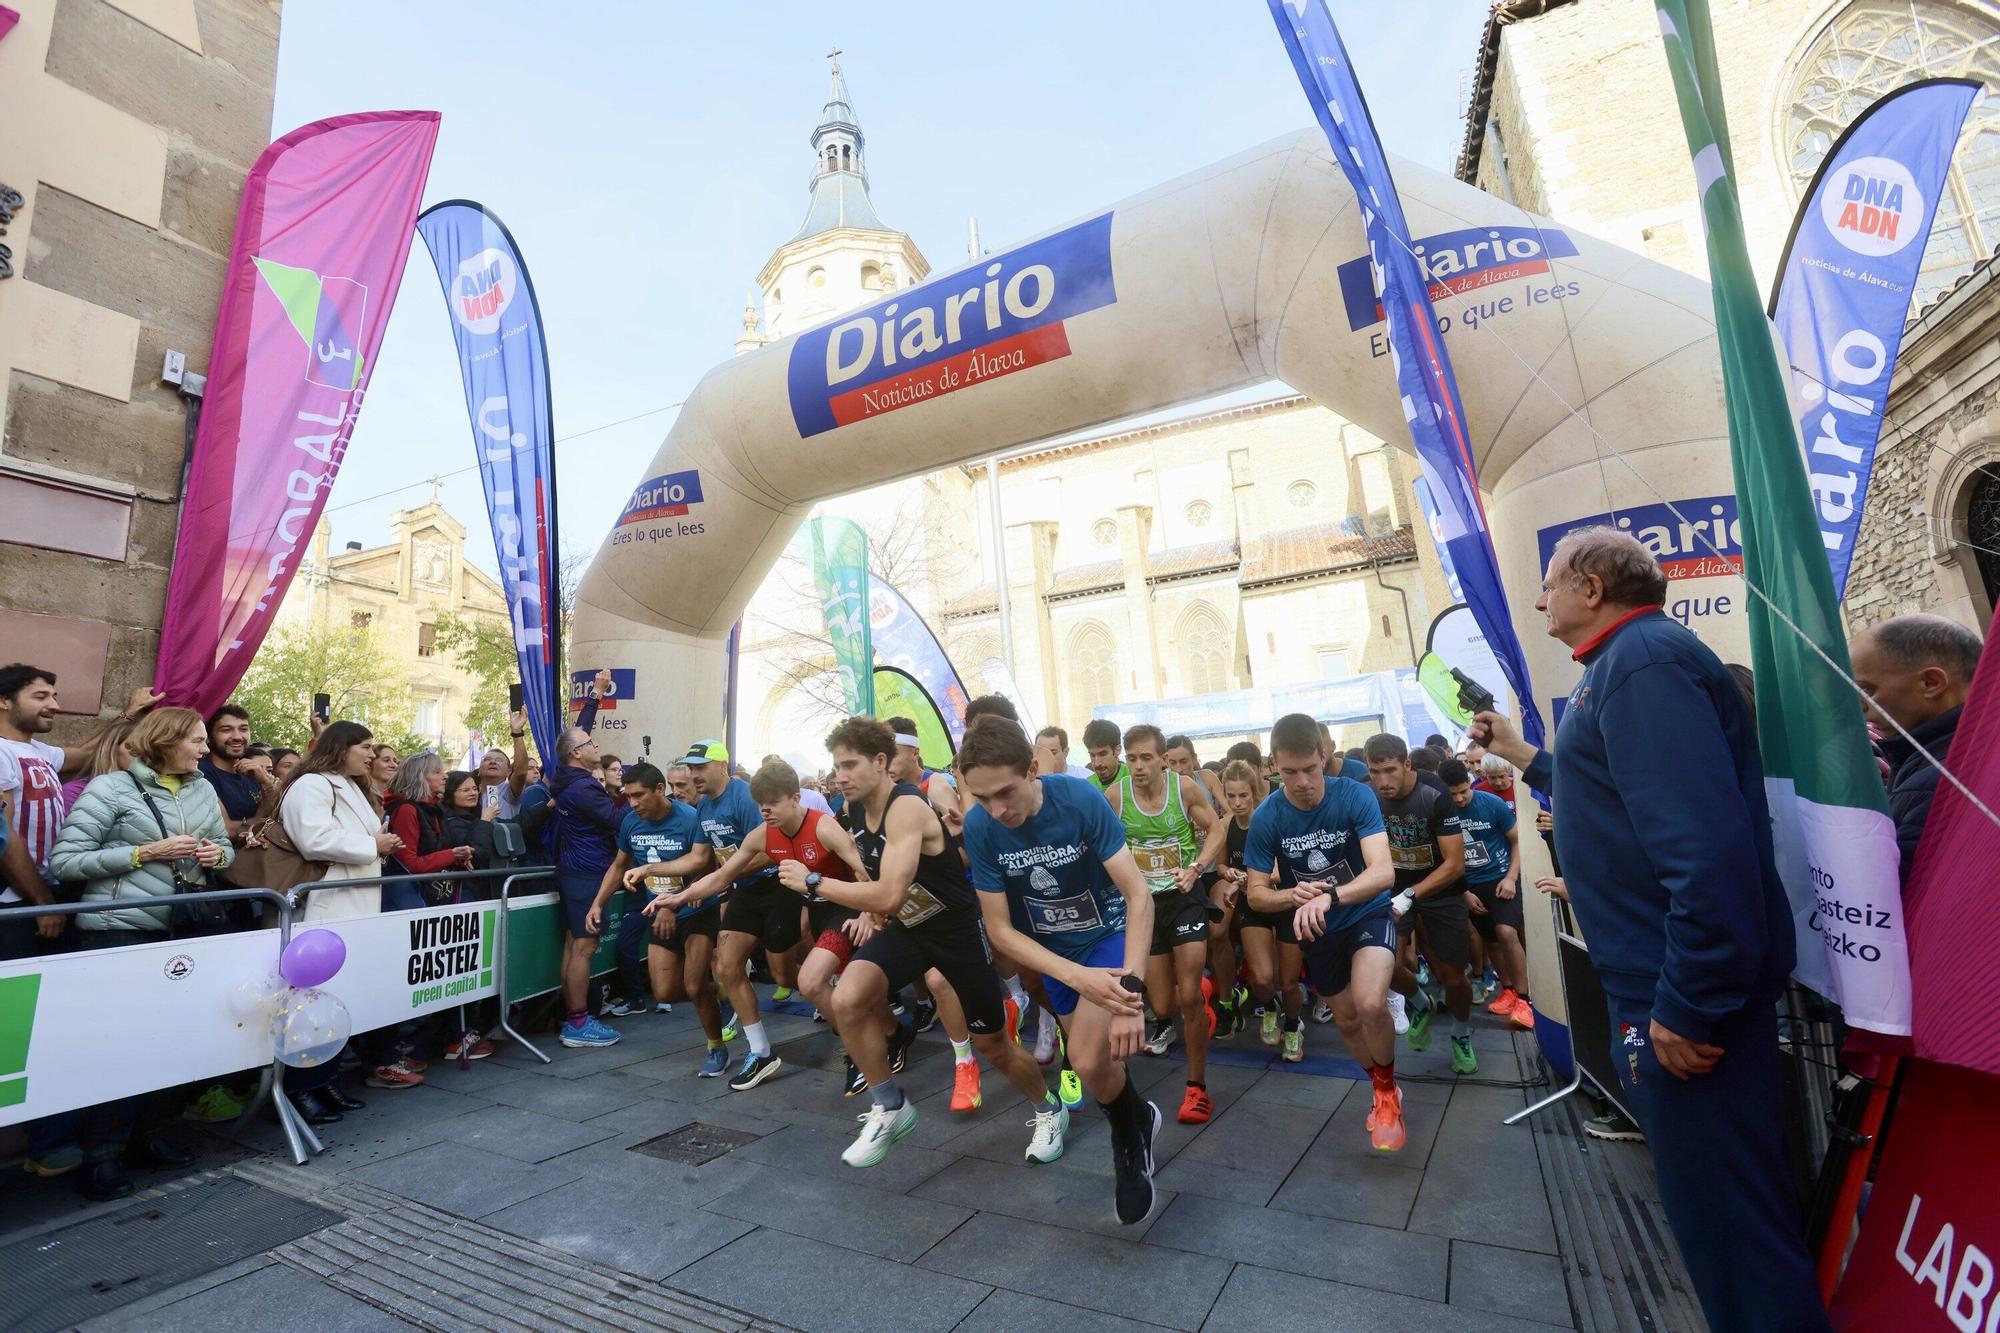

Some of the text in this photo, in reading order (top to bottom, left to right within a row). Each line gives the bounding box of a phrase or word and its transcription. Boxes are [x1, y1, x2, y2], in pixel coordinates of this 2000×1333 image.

[1843, 173, 1903, 214] DNA
[1838, 203, 1901, 240] ADN
[1370, 231, 1541, 299] iario
[1457, 278, 1473, 292] de
[1477, 268, 1521, 286] Álava
[1801, 256, 1840, 274] noticias
[1843, 268, 1856, 279] de
[1463, 297, 1513, 330] que
[1526, 281, 1581, 307] lees
[825, 263, 1055, 386] Diario
[862, 348, 1025, 414] Noticias de Álava
[613, 522, 705, 545] Eres lo que lees
[1668, 562, 1686, 579] de
[1672, 595, 1731, 626] que
[601, 715, 628, 730] lees
[1008, 845, 1077, 870] ALMENDRA
[1150, 855, 1165, 868] 67
[1464, 848, 1479, 859] 92
[1043, 906, 1079, 922] 825
[1817, 897, 1891, 929] asteiz
[410, 912, 480, 951] VITORIA
[407, 943, 479, 985] GASTEIZ
[412, 973, 478, 1009] green capital
[1896, 1193, 2000, 1333] LAB
